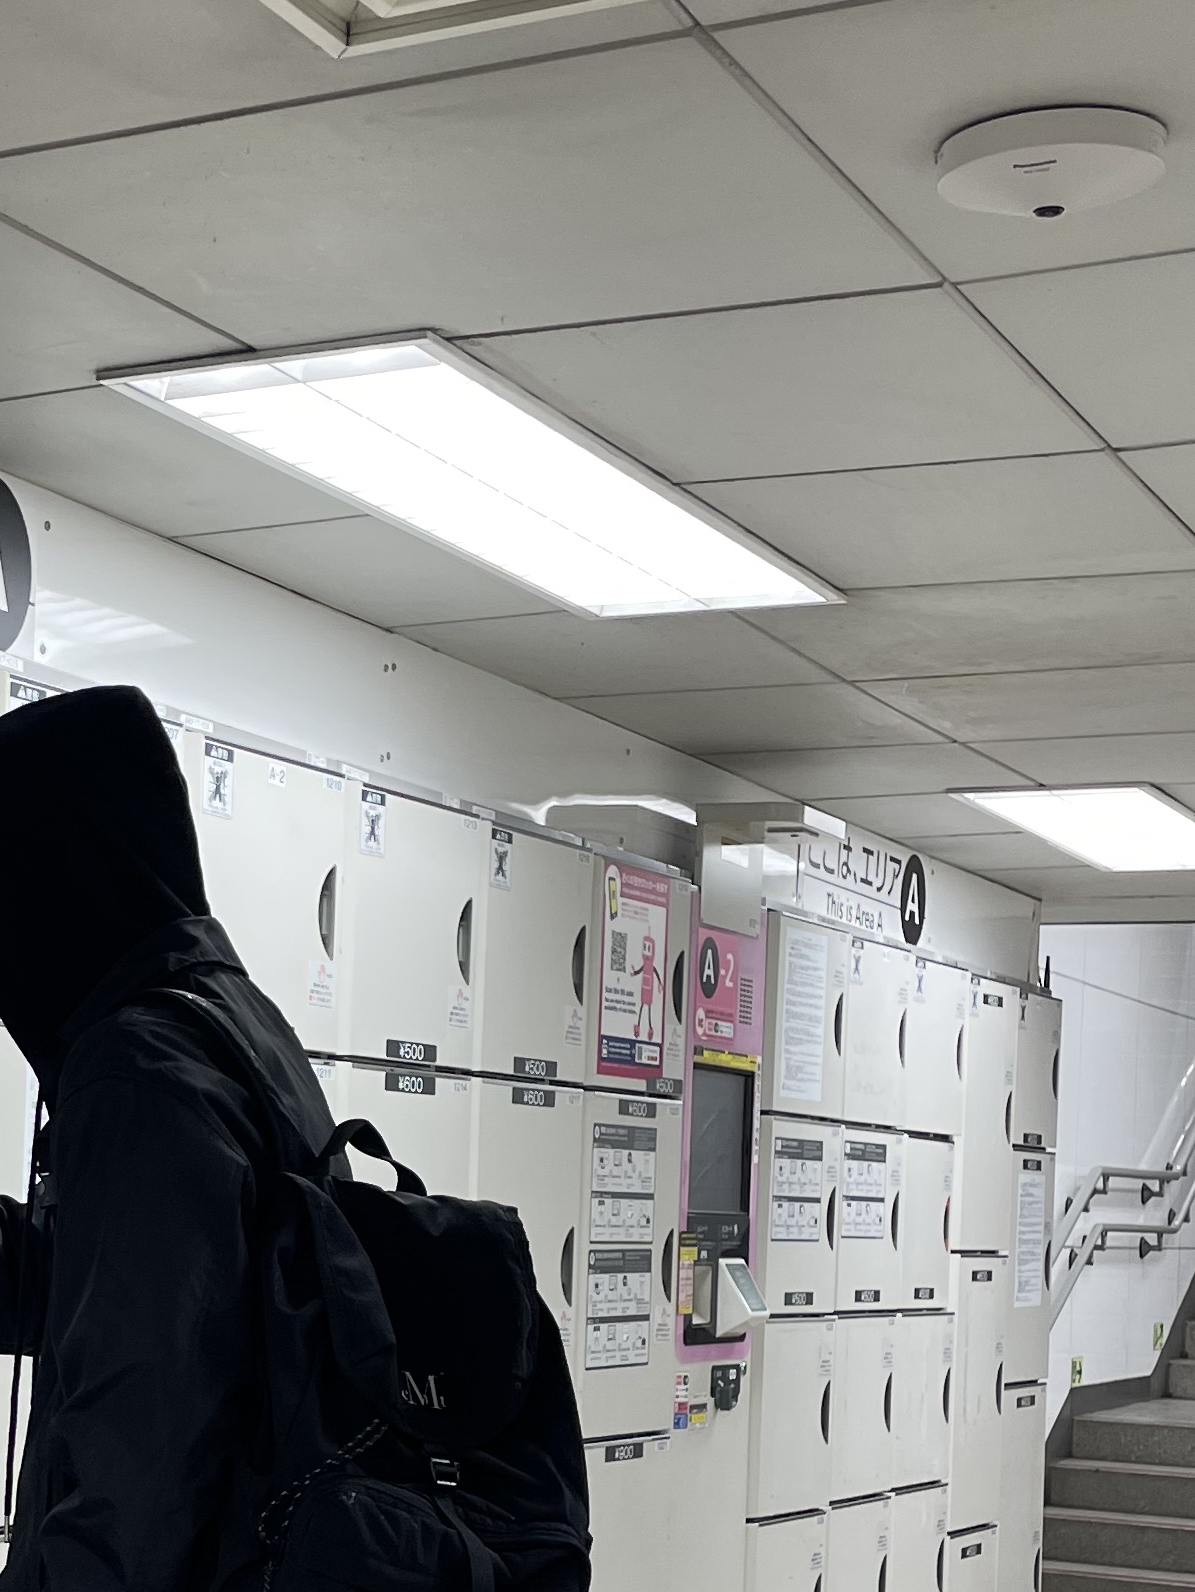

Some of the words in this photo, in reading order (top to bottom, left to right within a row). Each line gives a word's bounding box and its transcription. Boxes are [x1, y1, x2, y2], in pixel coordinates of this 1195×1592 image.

[269, 766, 286, 784] A-2
[325, 777, 343, 791] 1210
[905, 872, 919, 925] A
[826, 892, 844, 920] This
[846, 898, 853, 923] is
[855, 903, 875, 930] Area
[876, 911, 883, 933] A
[399, 1041, 425, 1061] ¥500
[525, 1060, 547, 1076] ¥500
[398, 1075, 424, 1093] ¥600
[523, 1090, 545, 1106] ¥600
